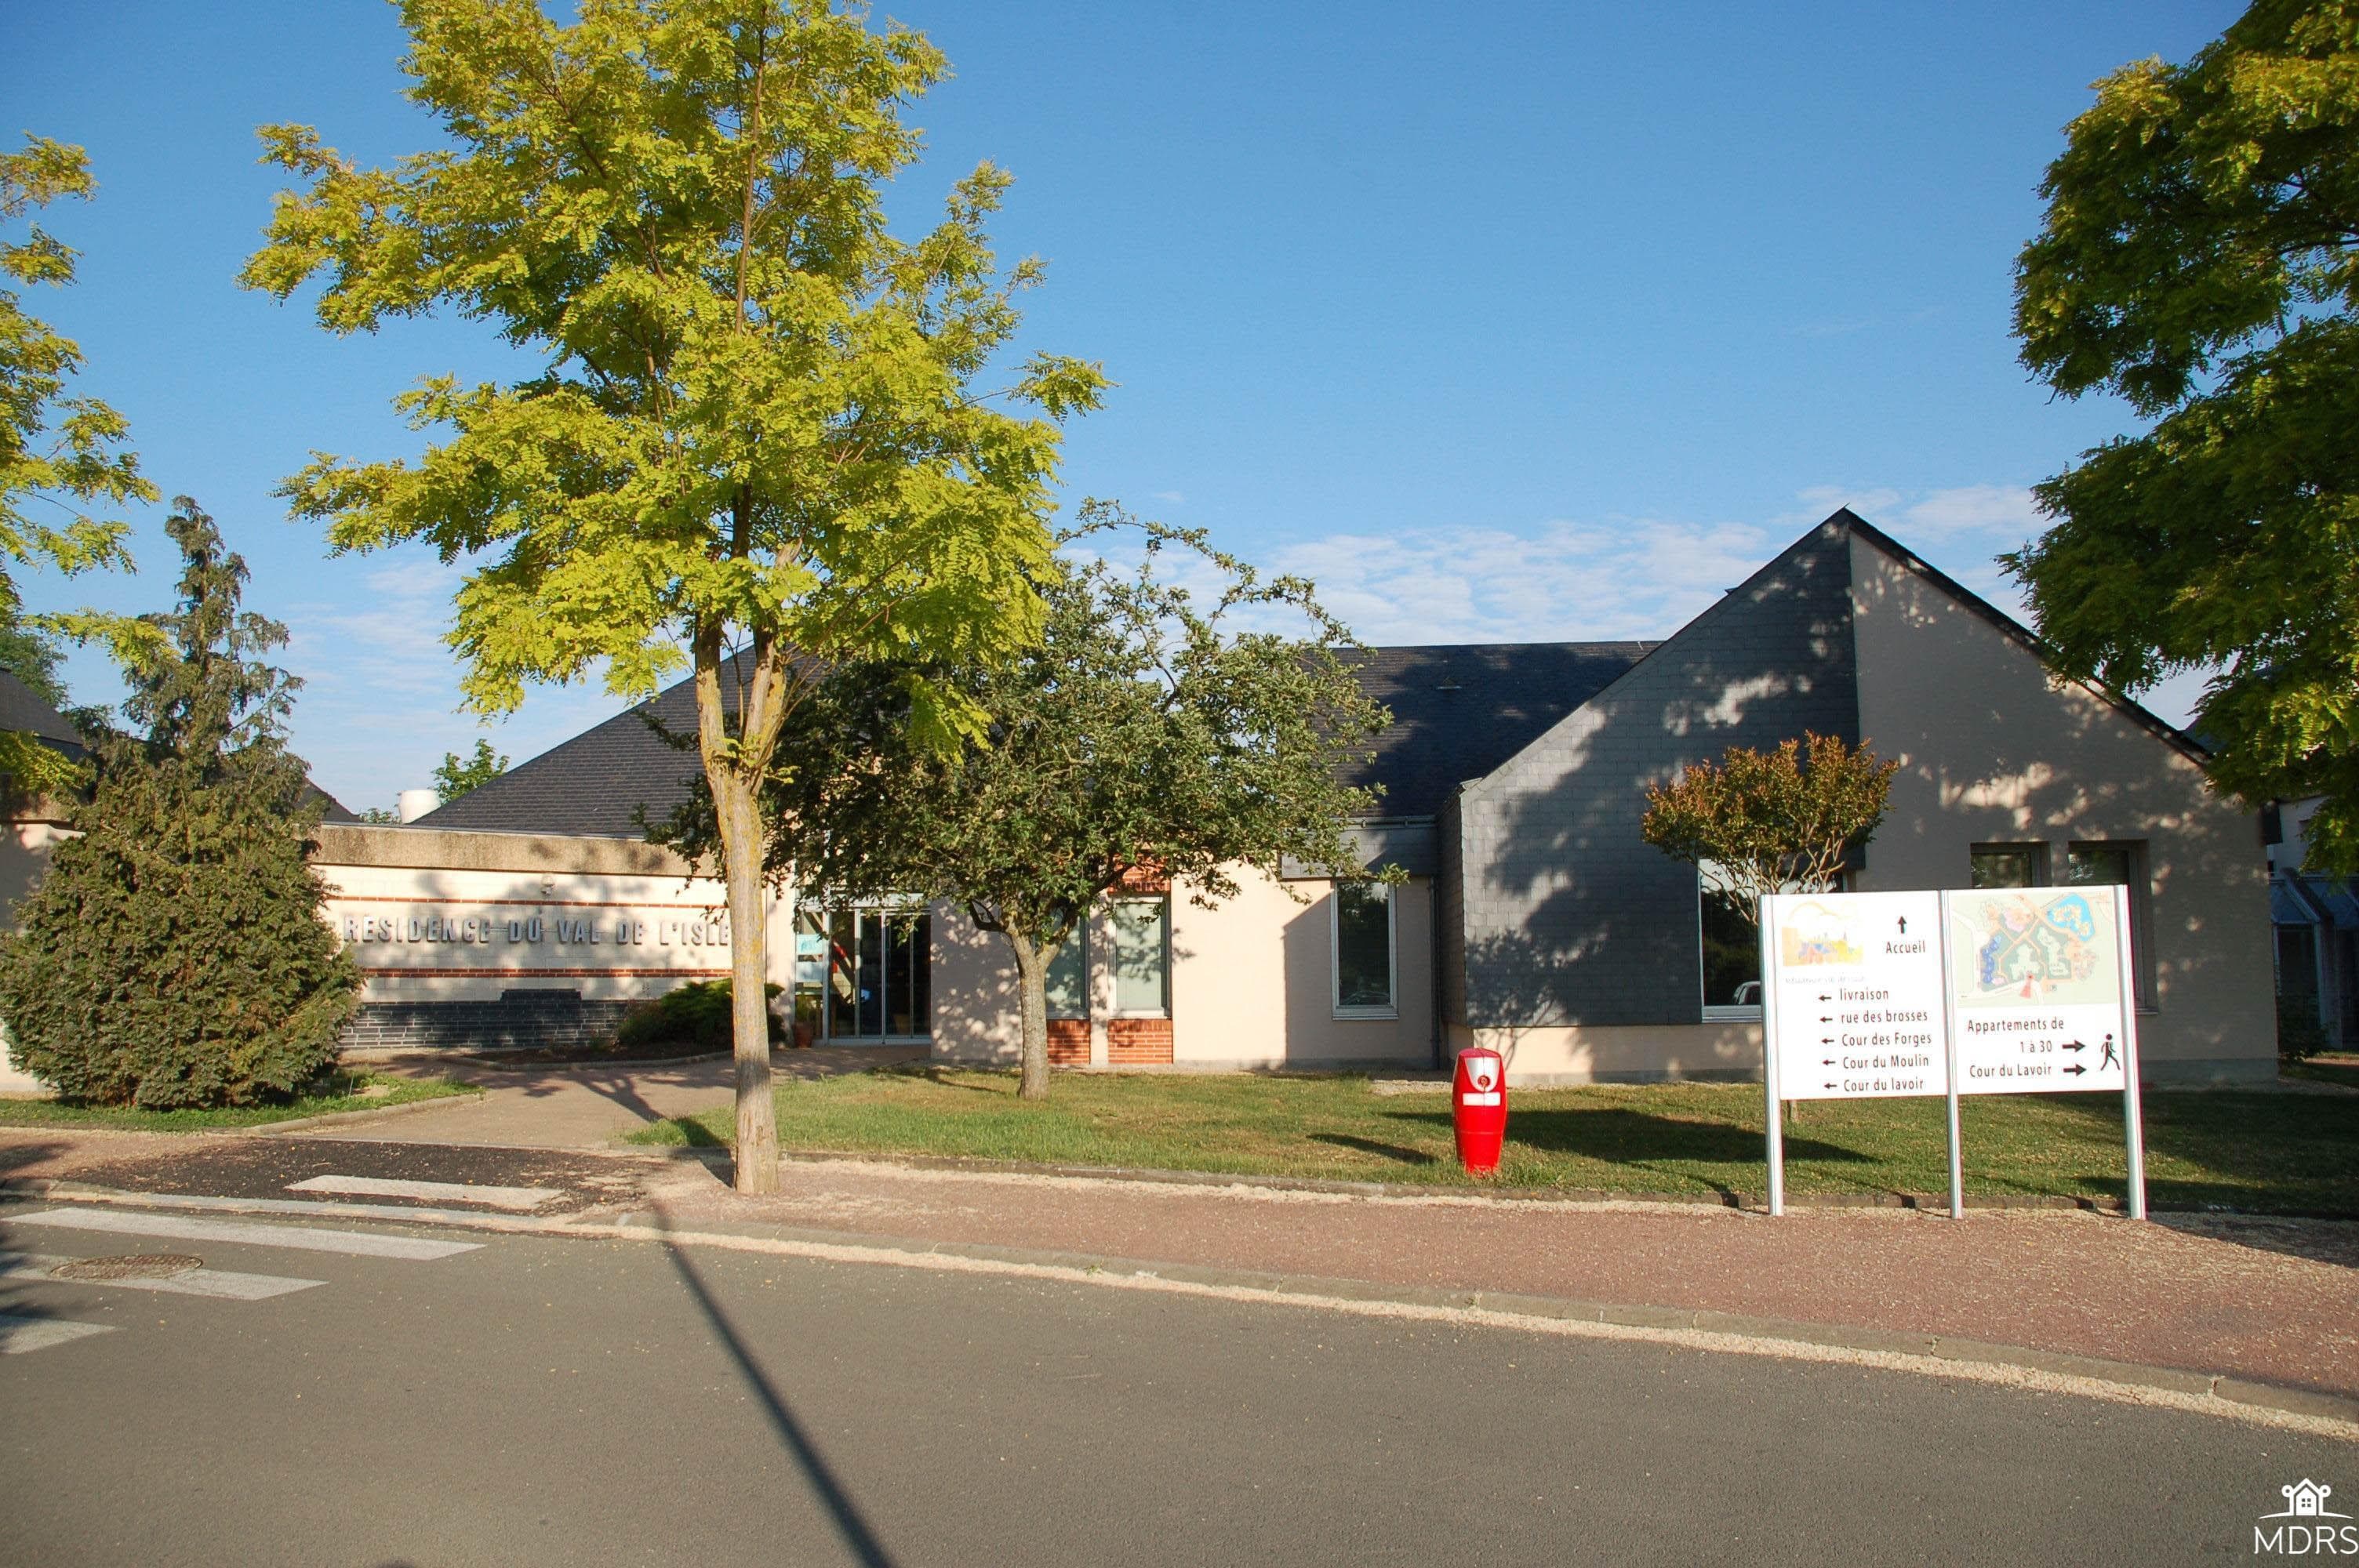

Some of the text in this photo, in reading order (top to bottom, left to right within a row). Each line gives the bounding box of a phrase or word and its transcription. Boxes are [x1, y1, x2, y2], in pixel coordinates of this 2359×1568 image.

[343, 916, 729, 946] RESIDENCE DU VAL DE L'ISLE
[1885, 939, 1926, 954] Accueil
[1840, 986, 1889, 1001] livraison
[1841, 1009, 1928, 1024] rue des brosses
[1968, 1016, 2064, 1035] Appartements de
[1841, 1031, 1932, 1047] Cour des Forges
[2030, 1040, 2035, 1053] à
[2040, 1040, 2052, 1053] 30
[1843, 1054, 1929, 1069] Cour du Moulin
[1969, 1062, 2052, 1077] Cour du Lavoir
[1844, 1076, 1924, 1092] Cour du lavoir
